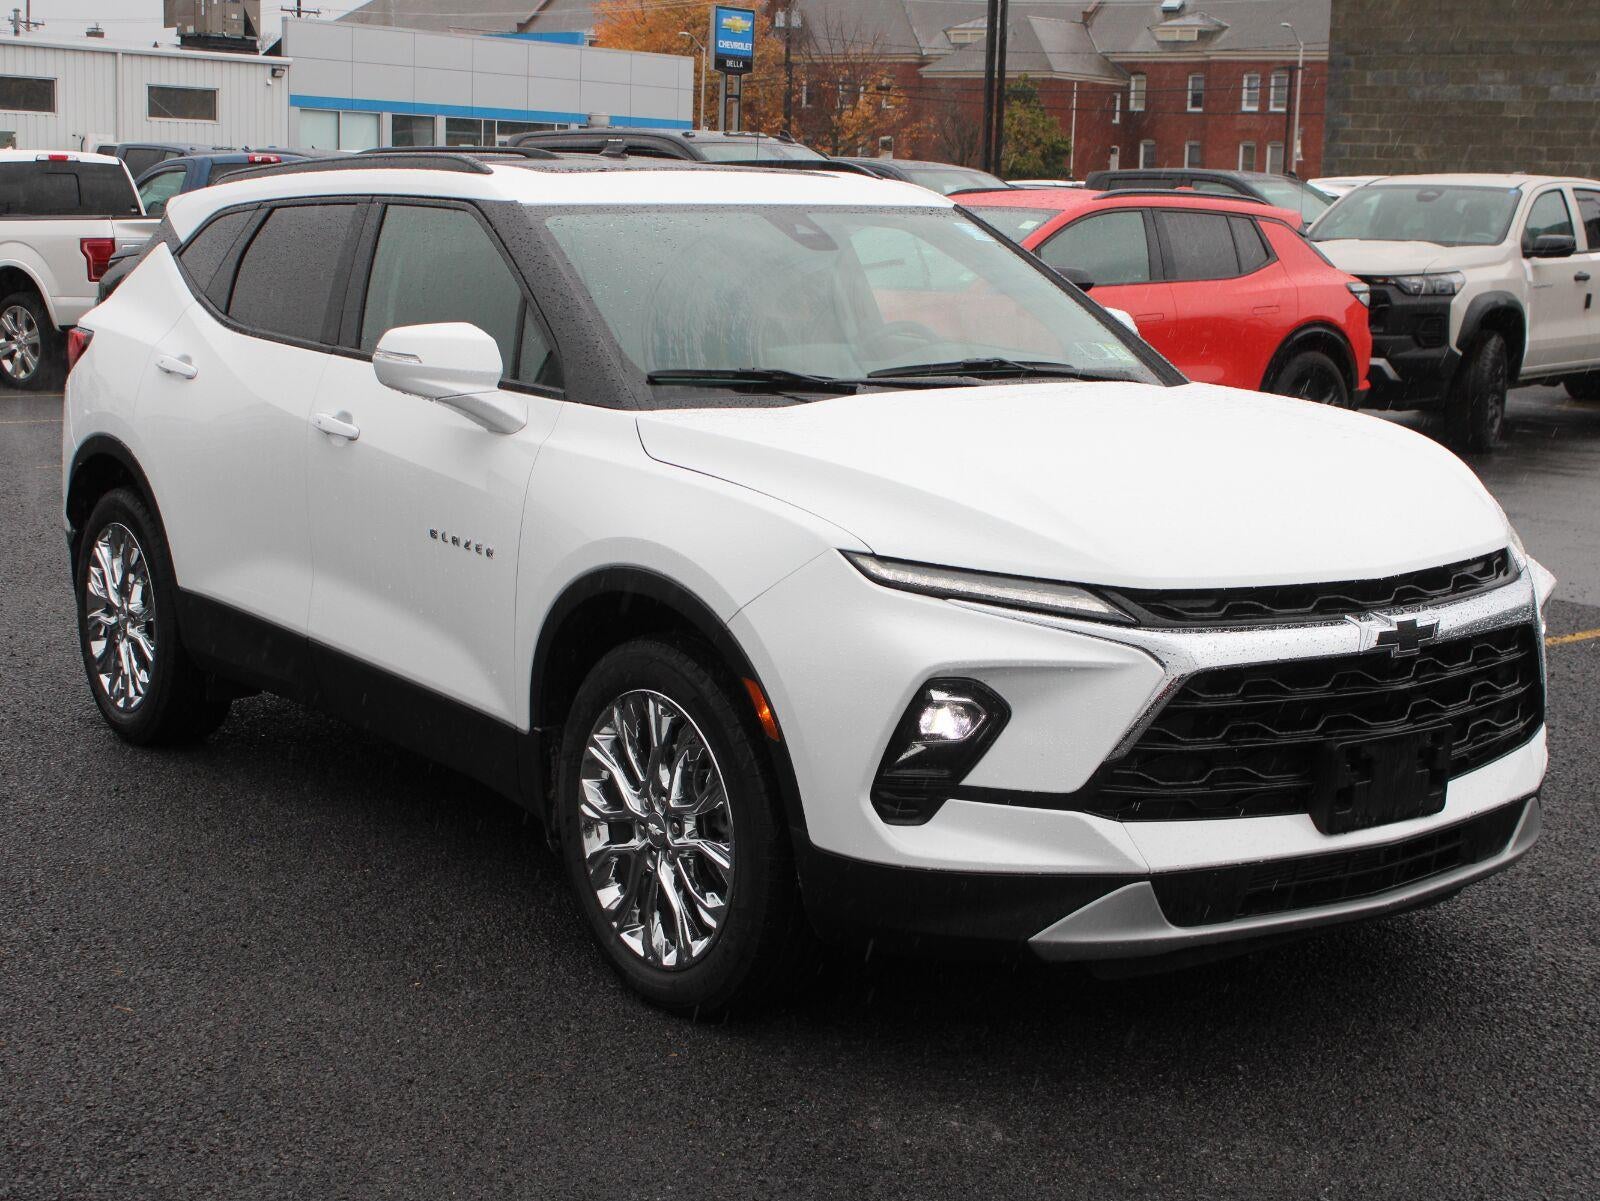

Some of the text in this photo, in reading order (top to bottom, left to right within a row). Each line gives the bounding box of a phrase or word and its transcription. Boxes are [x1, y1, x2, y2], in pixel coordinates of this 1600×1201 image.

[718, 40, 752, 51] CHEVROLET
[726, 59, 743, 68] DELLA
[429, 528, 494, 558] BLAZER
